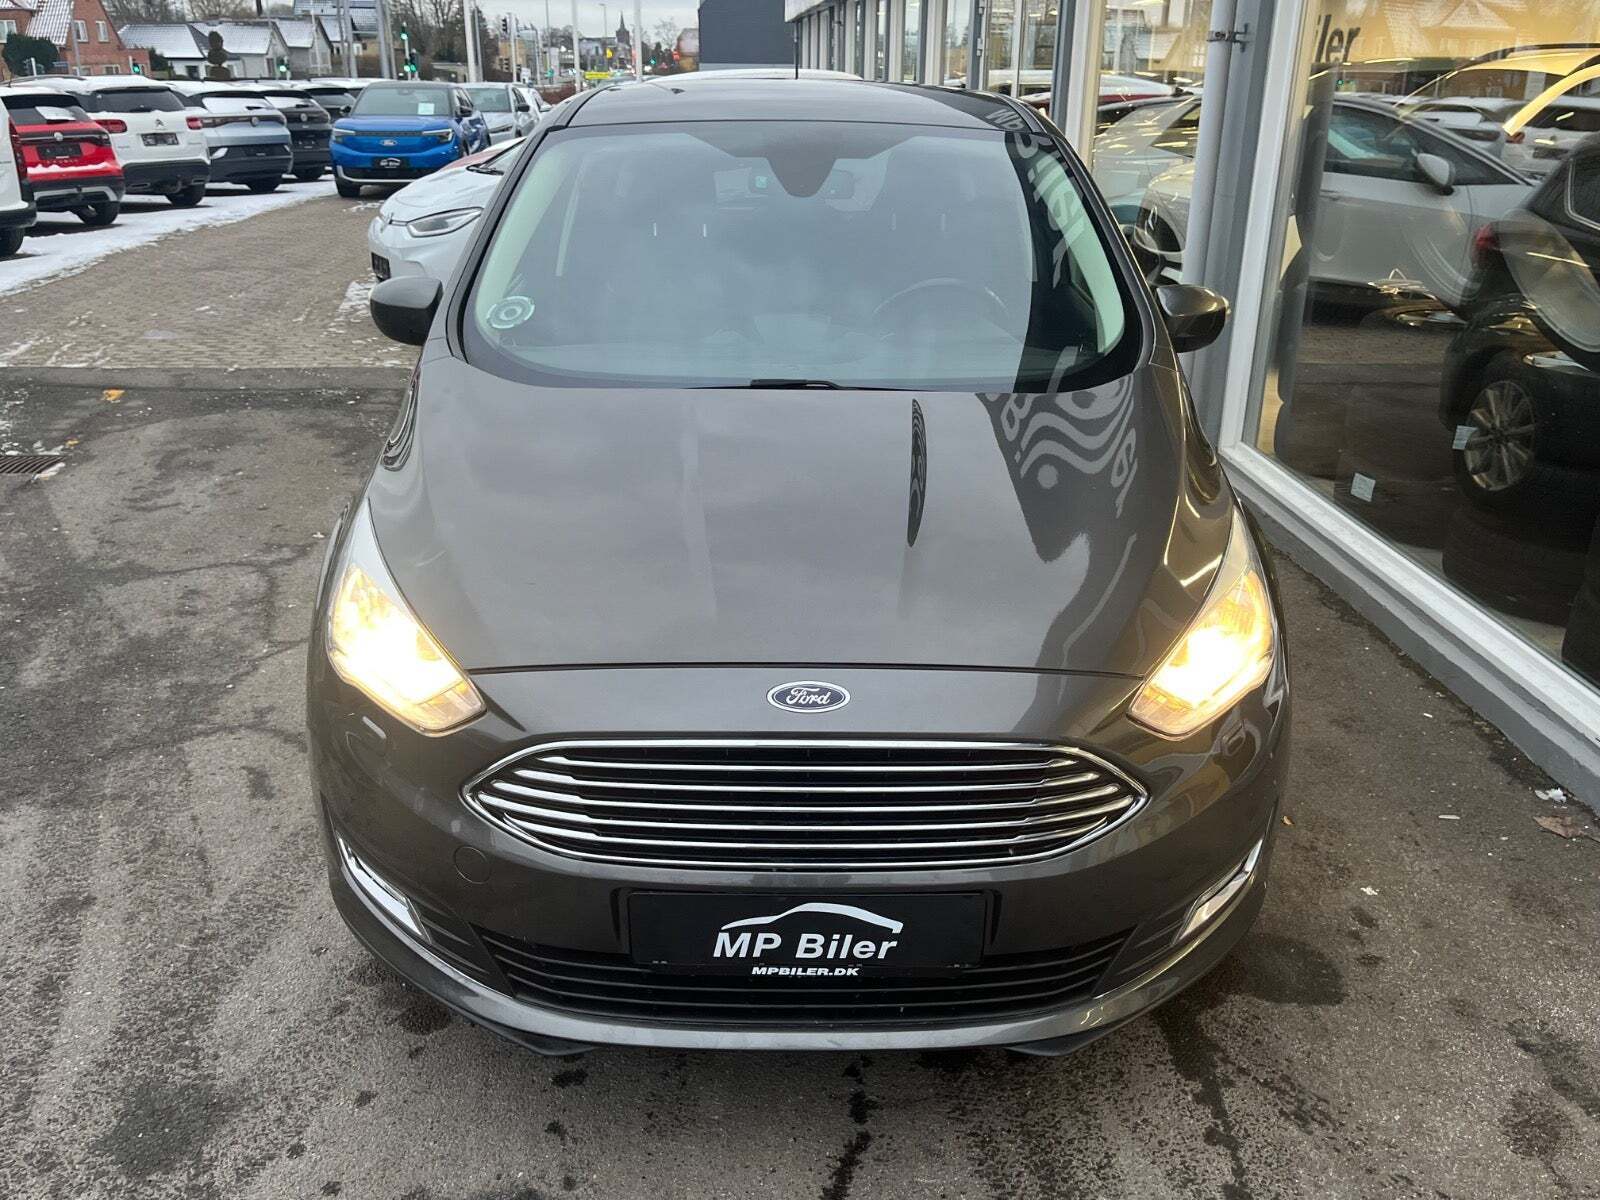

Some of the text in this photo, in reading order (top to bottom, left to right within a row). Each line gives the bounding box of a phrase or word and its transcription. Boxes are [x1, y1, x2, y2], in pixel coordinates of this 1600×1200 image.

[785, 687, 832, 705] Ford
[712, 932, 898, 959] MP Biler
[751, 966, 861, 976] MPBILER.DK
